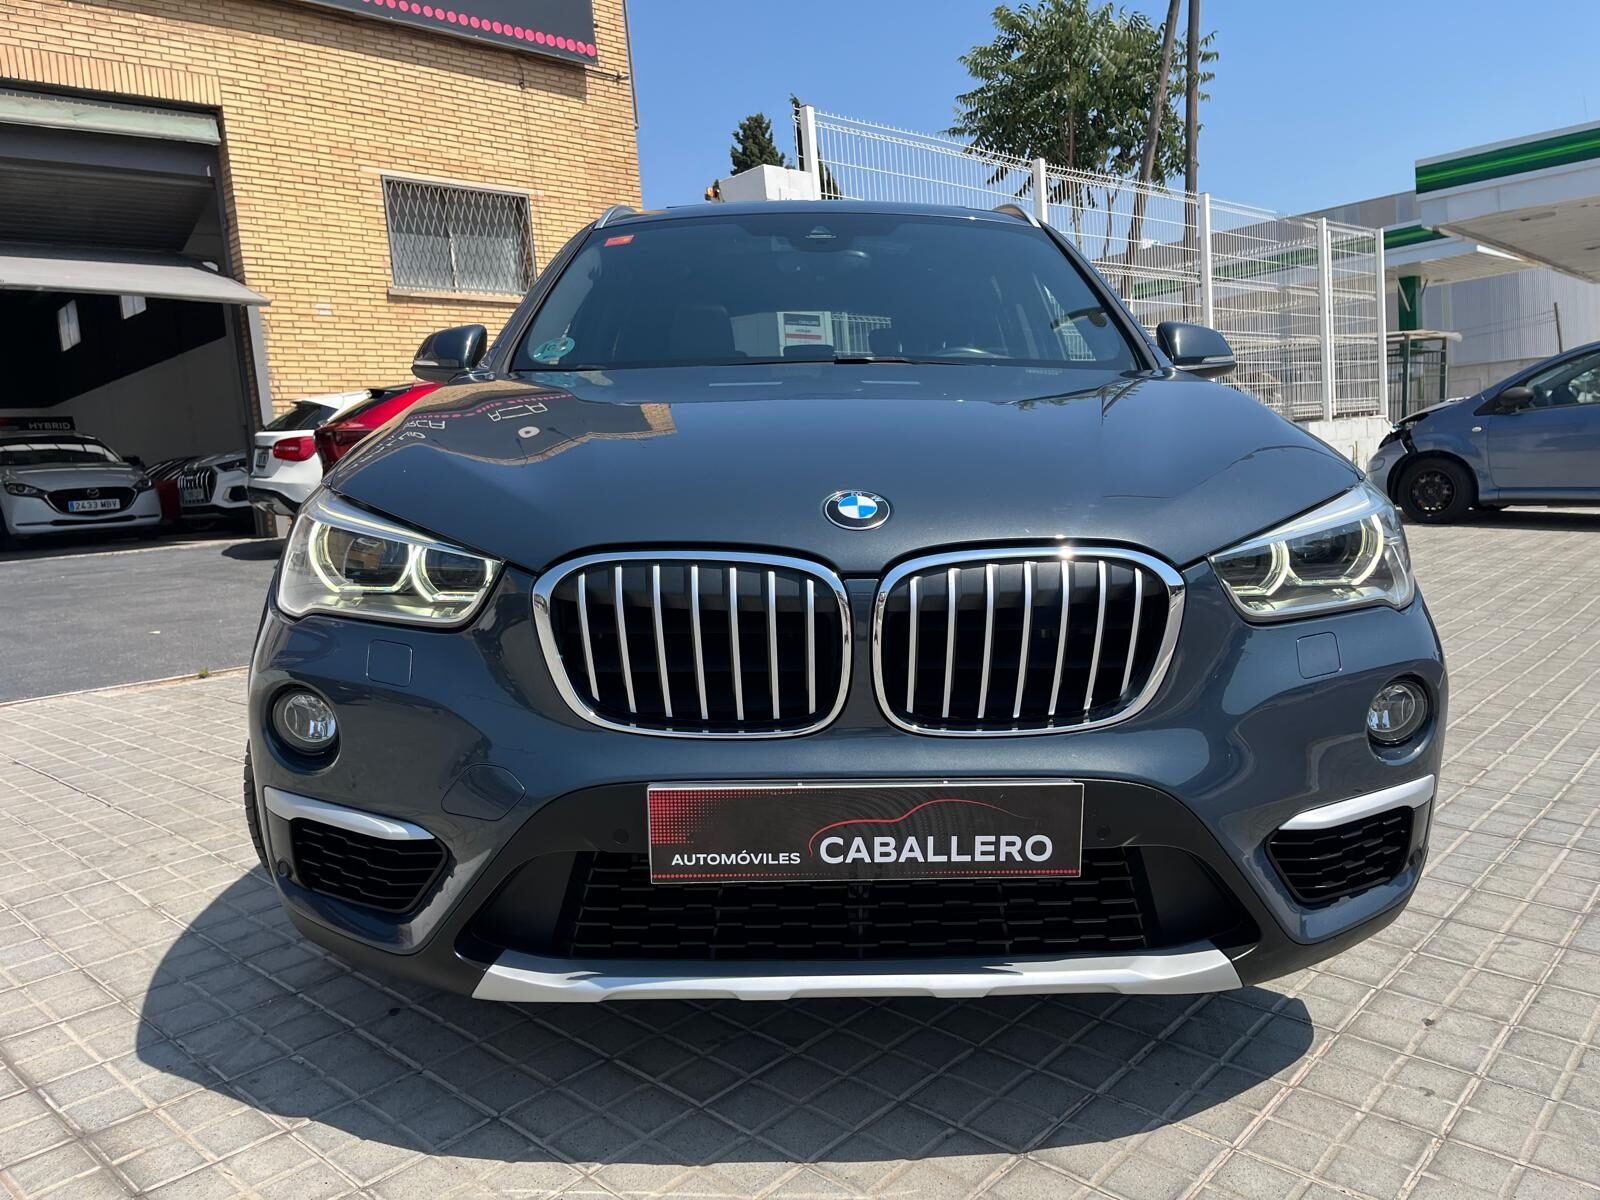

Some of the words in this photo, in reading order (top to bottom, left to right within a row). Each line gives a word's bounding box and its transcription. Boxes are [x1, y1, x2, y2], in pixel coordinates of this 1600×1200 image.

[28, 421, 71, 430] HYBRID
[671, 850, 801, 866] AUTOMÓVILES
[819, 834, 1053, 864] CABALLERO
